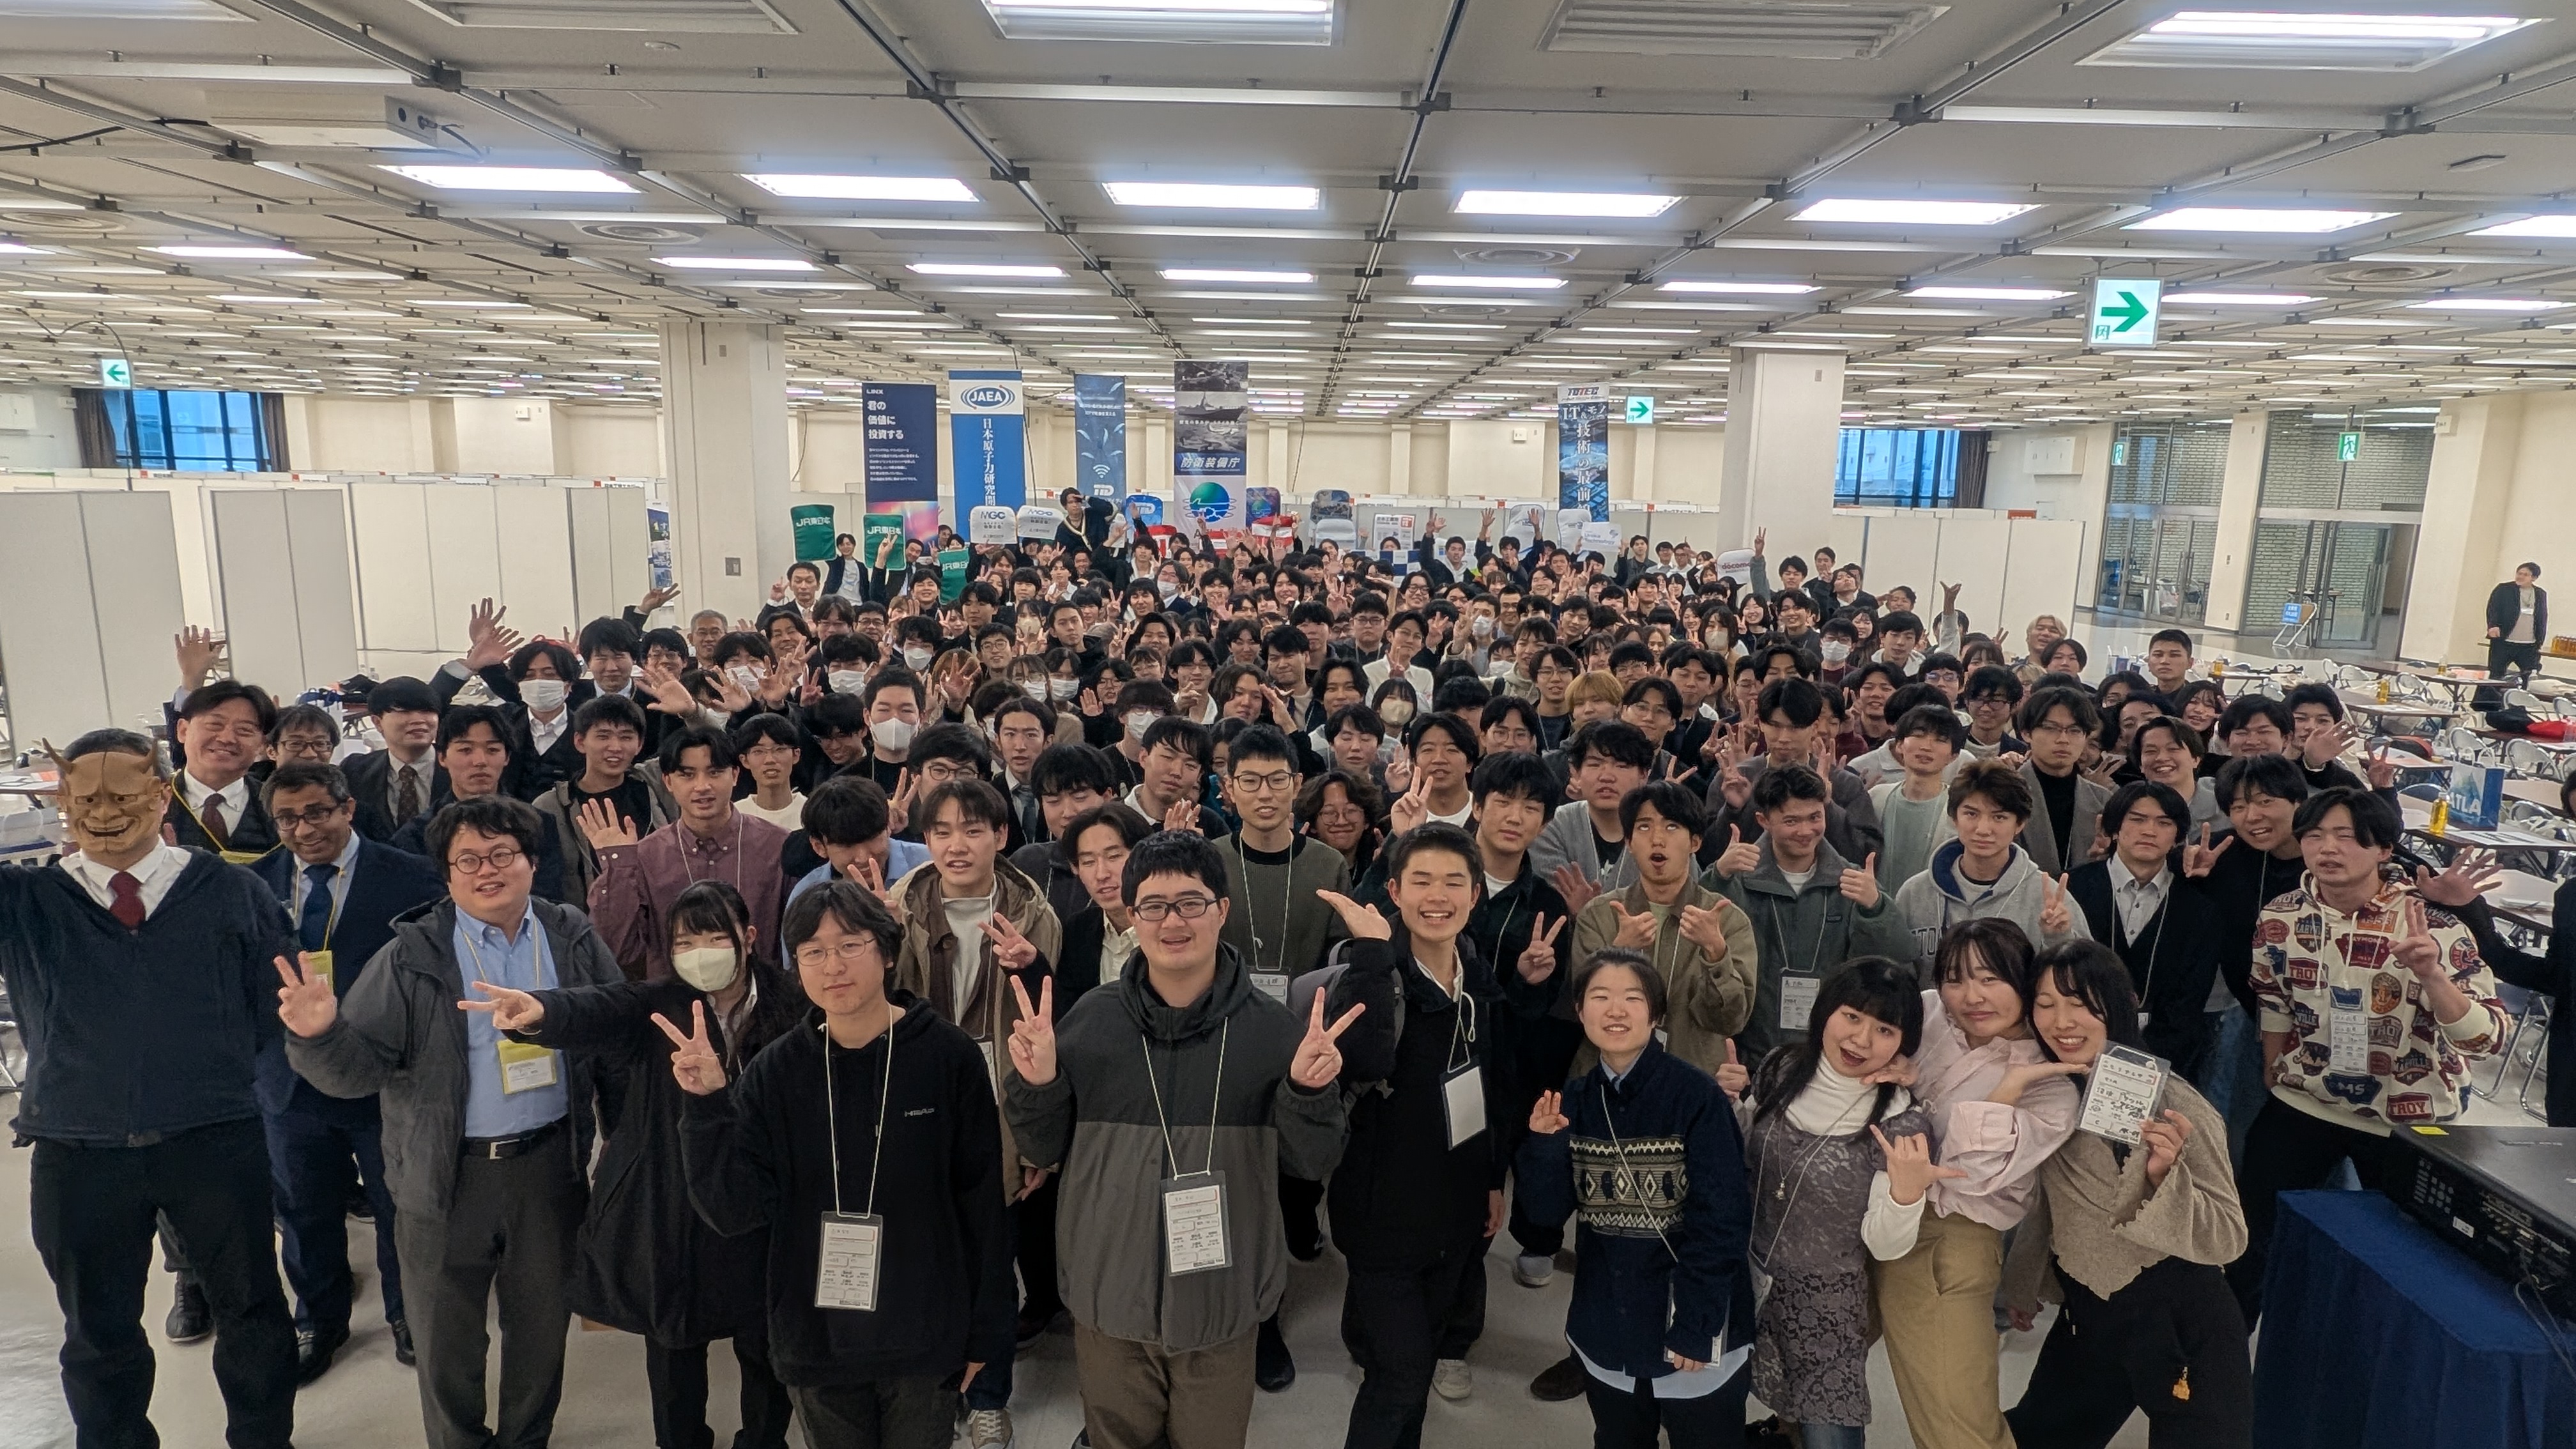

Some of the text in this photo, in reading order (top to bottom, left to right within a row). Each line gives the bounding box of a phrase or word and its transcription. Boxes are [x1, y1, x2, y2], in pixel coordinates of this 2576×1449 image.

[970, 391, 1002, 401] JAEA
[867, 401, 887, 411] 君の
[868, 415, 896, 425] 価値に
[868, 429, 904, 440] 投資する
[1180, 457, 1241, 468] 防衛装備庁
[2389, 1100, 2427, 1115] TROY
